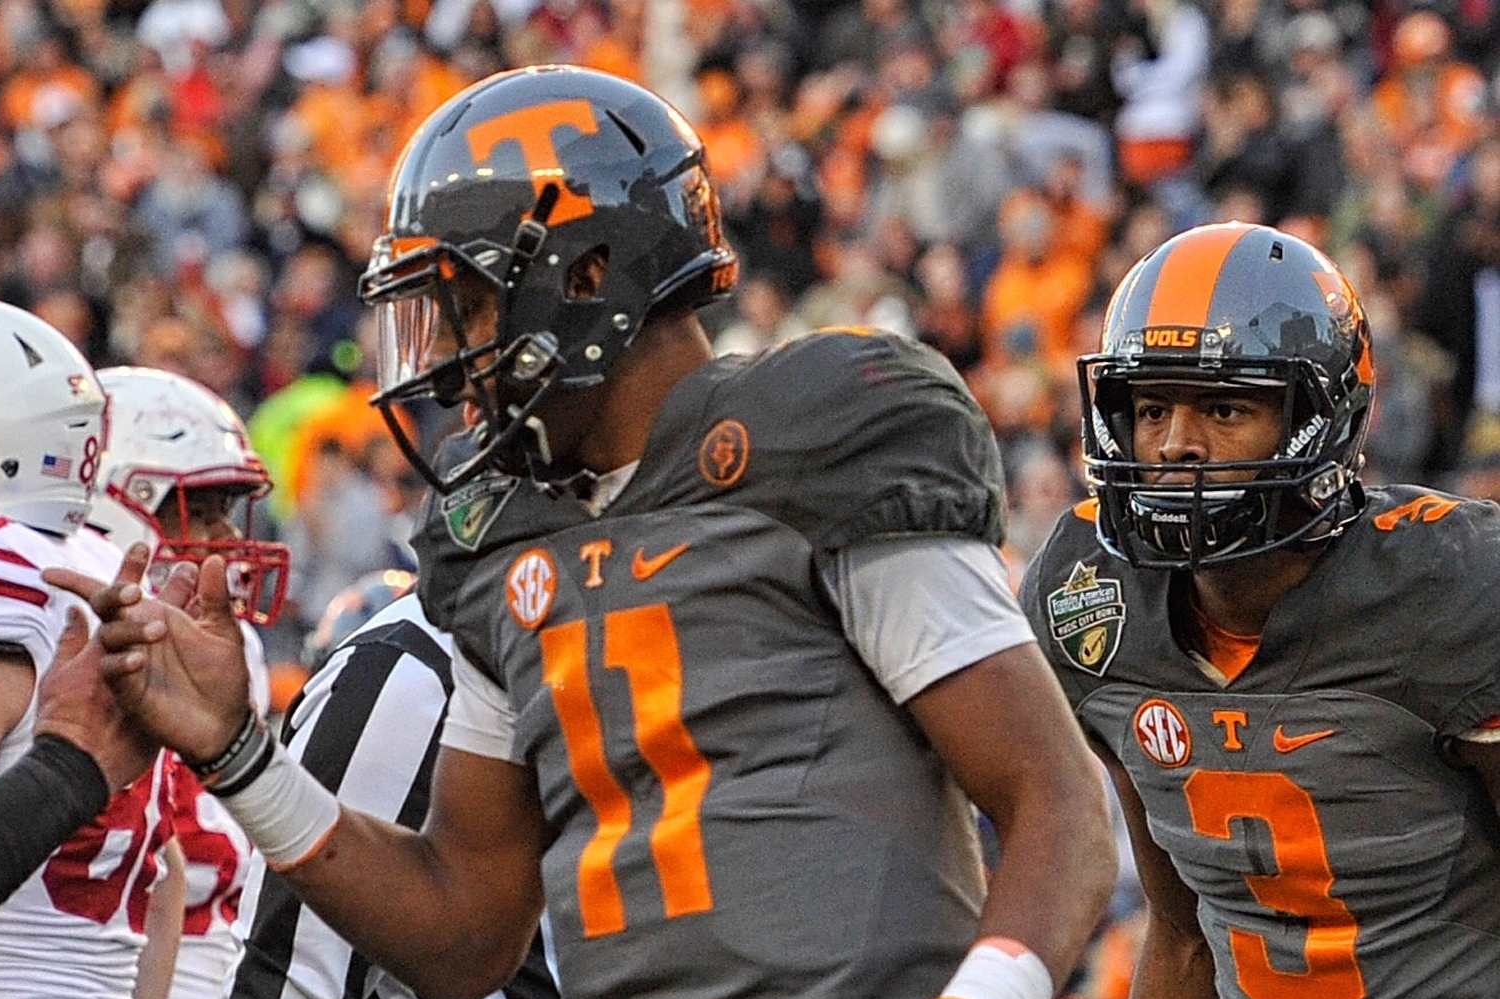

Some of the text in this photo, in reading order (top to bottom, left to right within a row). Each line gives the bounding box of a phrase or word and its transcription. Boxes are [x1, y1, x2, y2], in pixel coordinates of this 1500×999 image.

[467, 97, 598, 228] T
[1145, 330, 1197, 347] VOLS
[510, 554, 553, 622] SEC
[580, 539, 612, 588] T
[1138, 705, 1187, 764] SEC
[1212, 709, 1248, 750] T
[540, 603, 713, 938] 11
